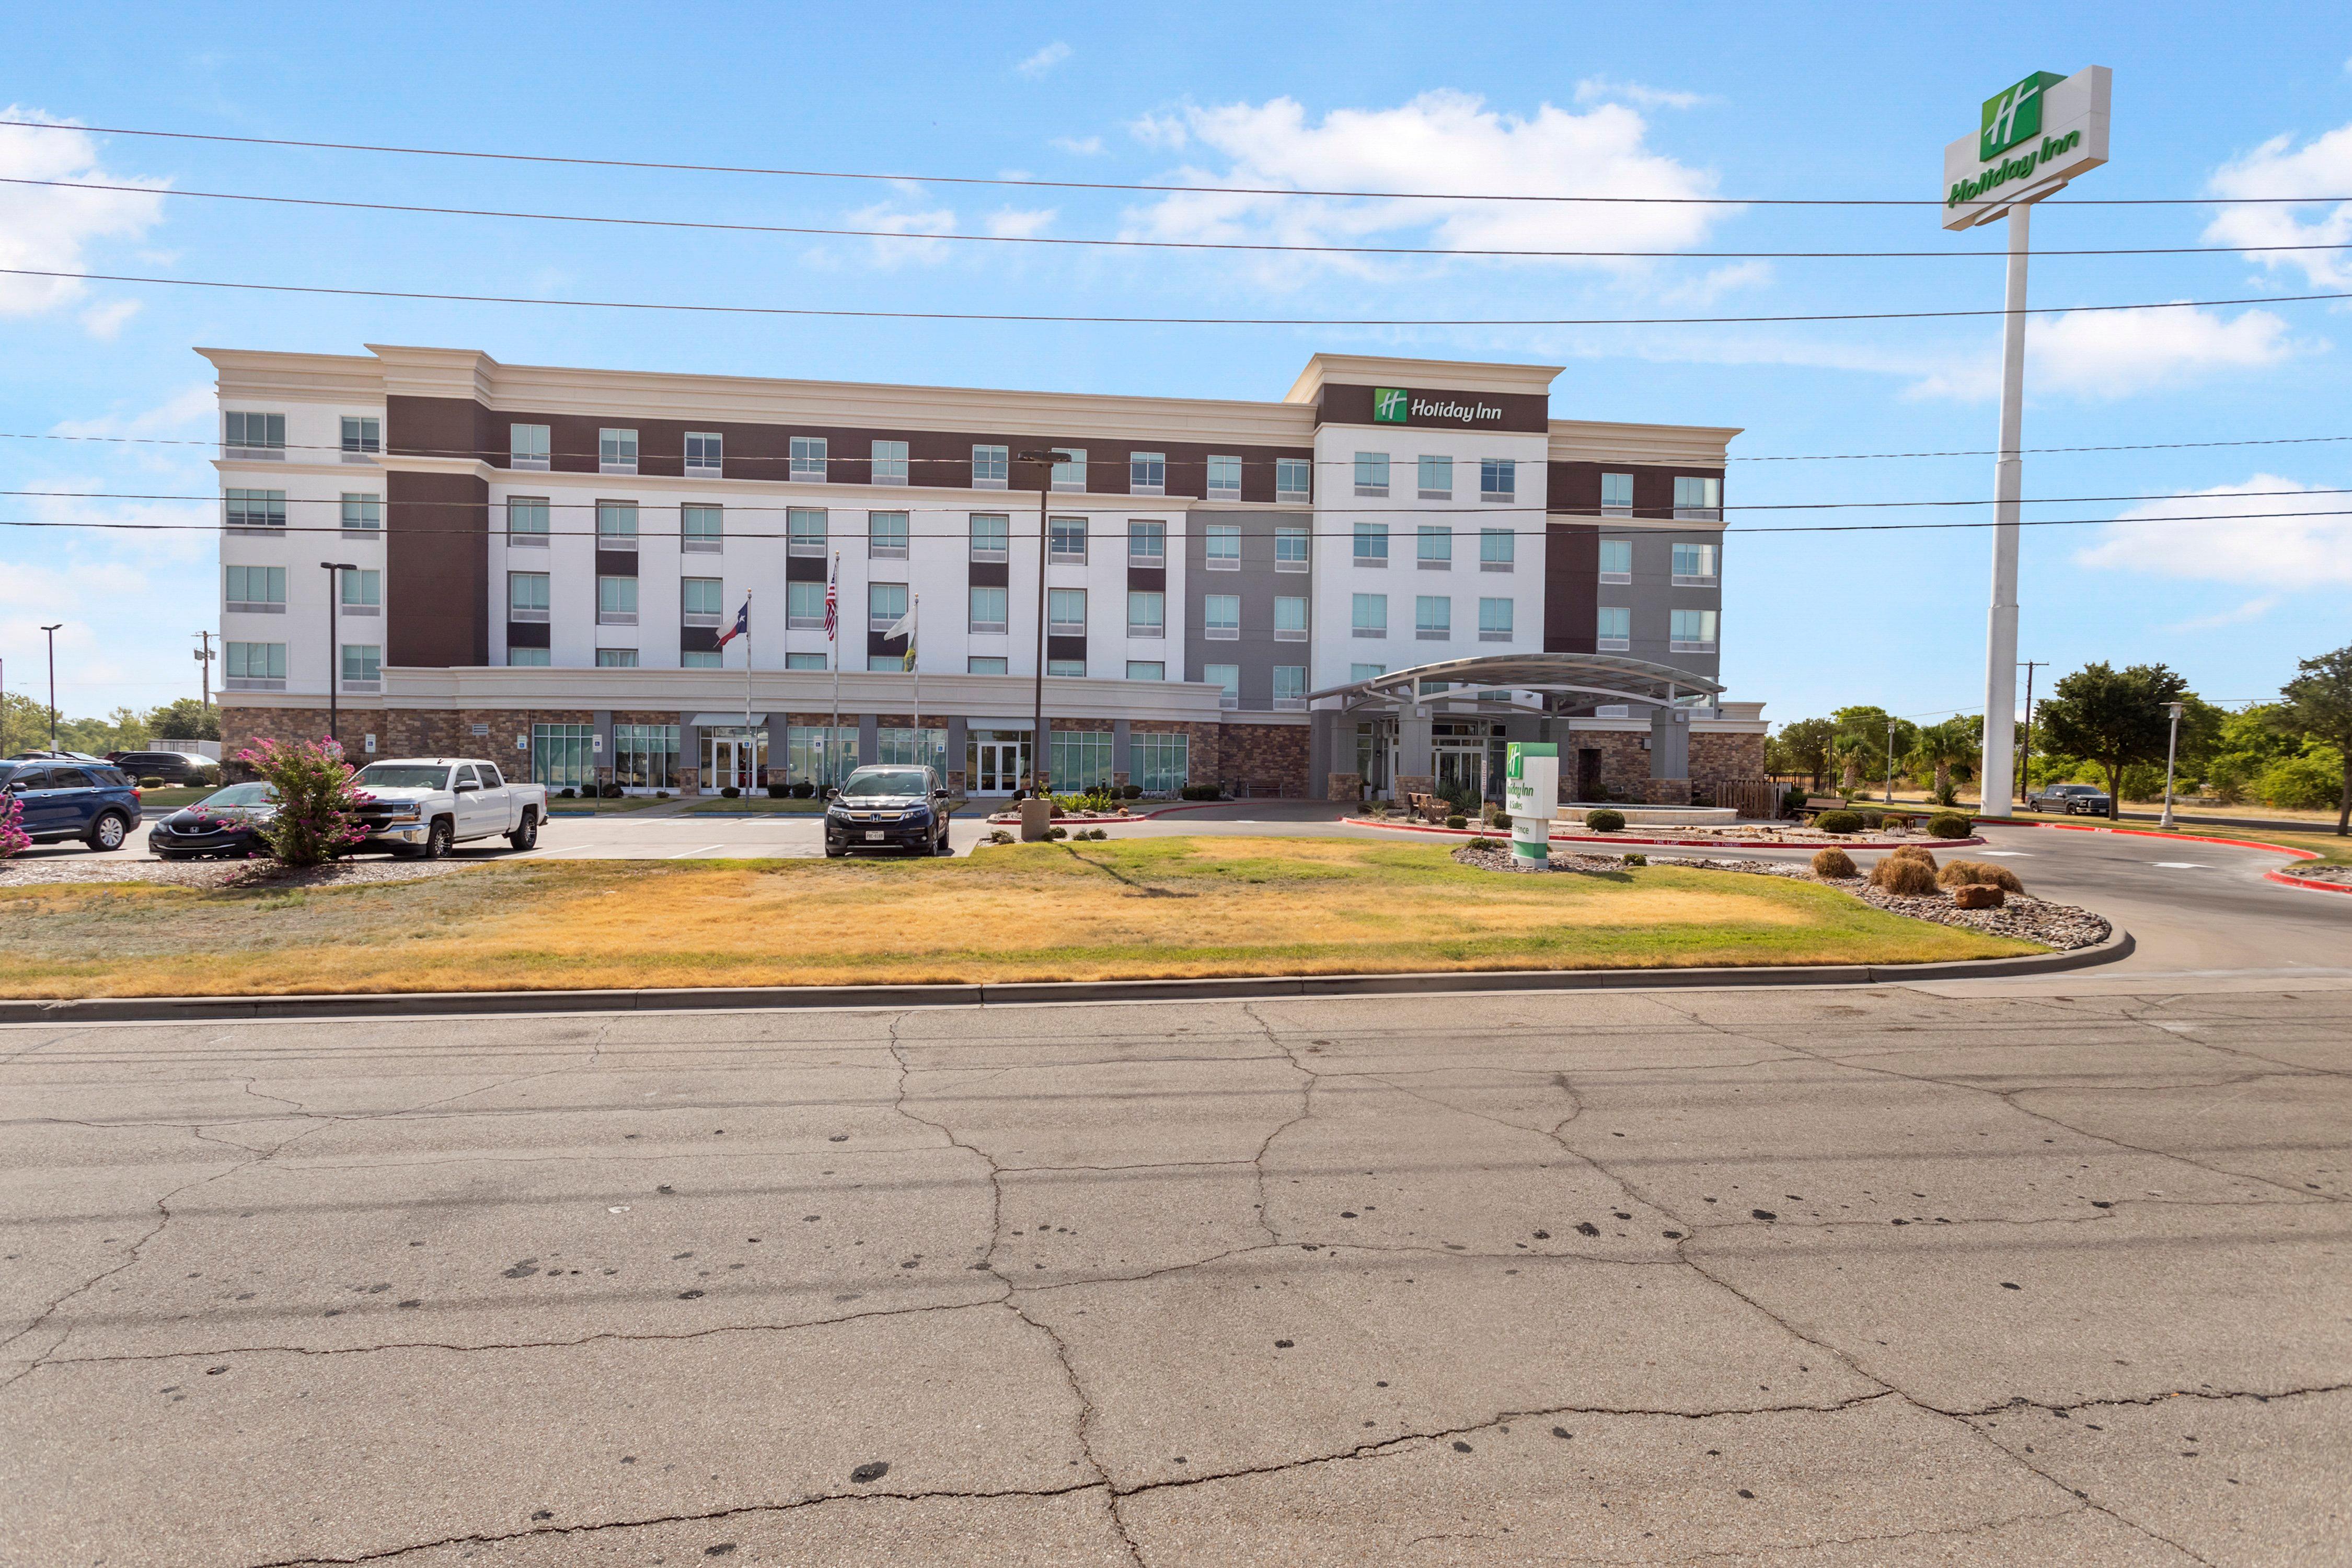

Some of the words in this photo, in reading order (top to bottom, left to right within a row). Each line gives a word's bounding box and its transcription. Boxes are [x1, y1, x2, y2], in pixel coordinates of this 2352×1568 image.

[1948, 151, 2038, 209] Holiday
[2039, 130, 2081, 164] Inn
[1411, 399, 1475, 422] Holiday
[1476, 402, 1502, 420] Inn
[1522, 782, 1534, 796] Inn
